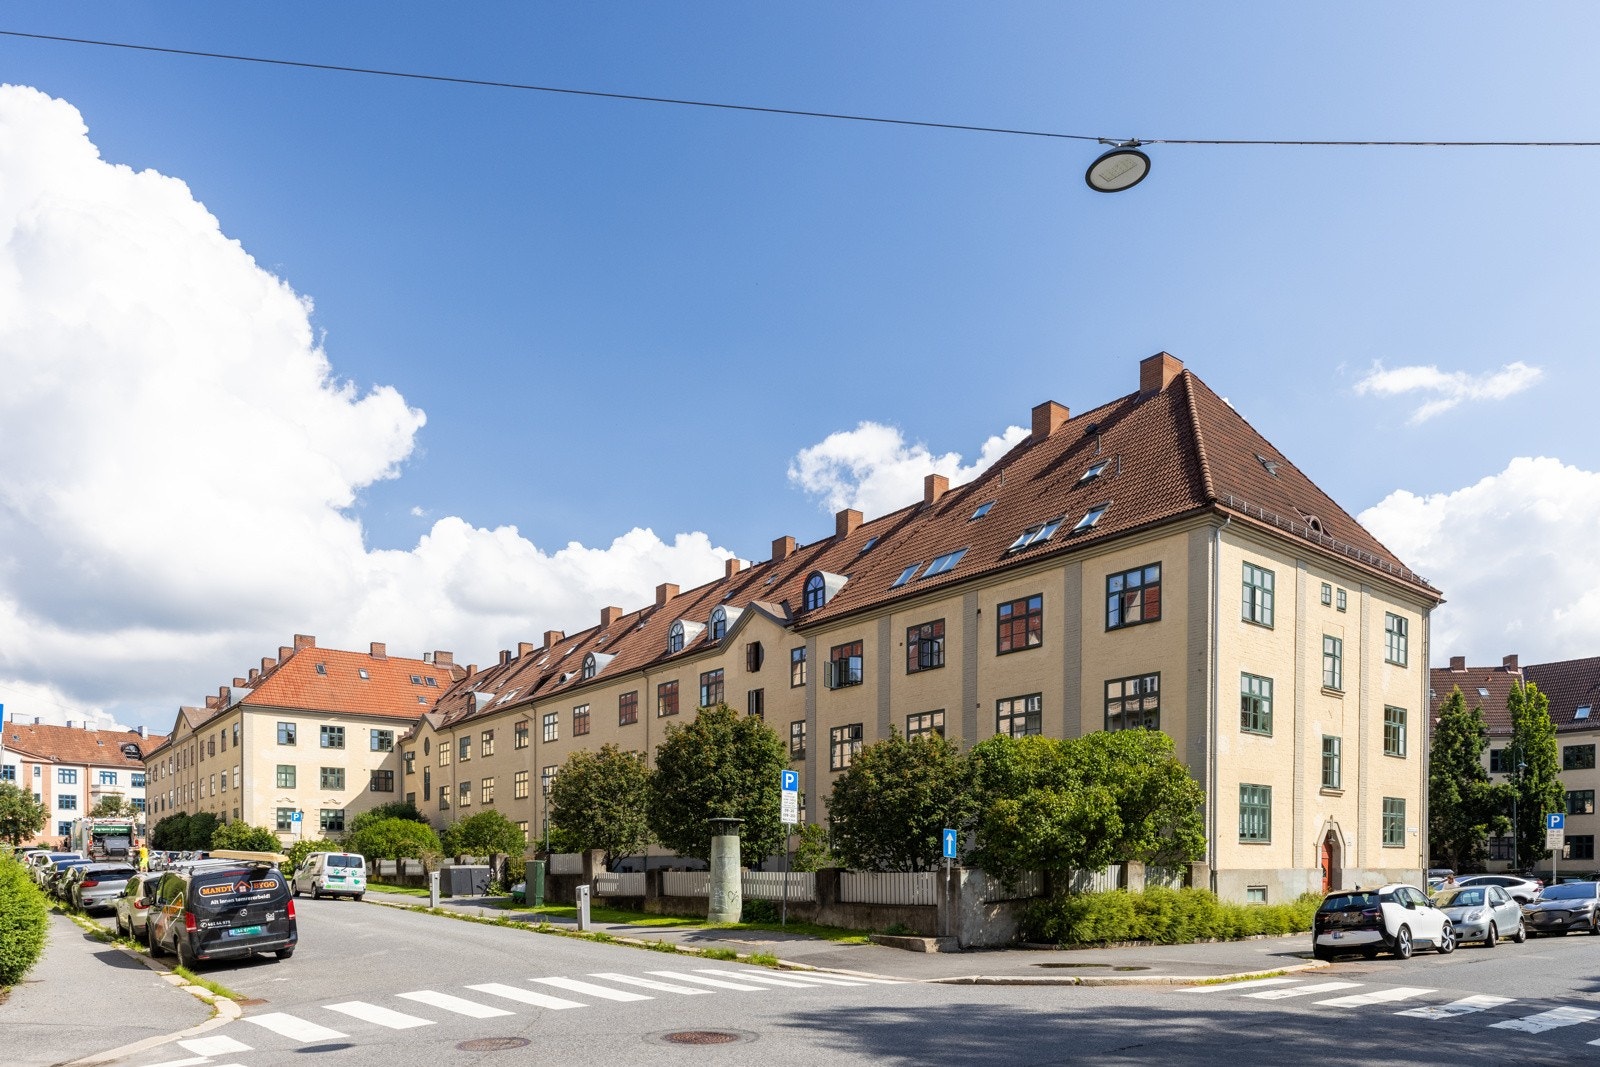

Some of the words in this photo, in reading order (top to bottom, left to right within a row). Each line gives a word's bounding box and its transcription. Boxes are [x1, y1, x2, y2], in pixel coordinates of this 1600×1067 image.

[785, 773, 795, 789] P
[293, 813, 300, 821] P
[1551, 815, 1560, 827] P
[202, 885, 232, 895] MANDT
[253, 881, 275, 889] BYGG
